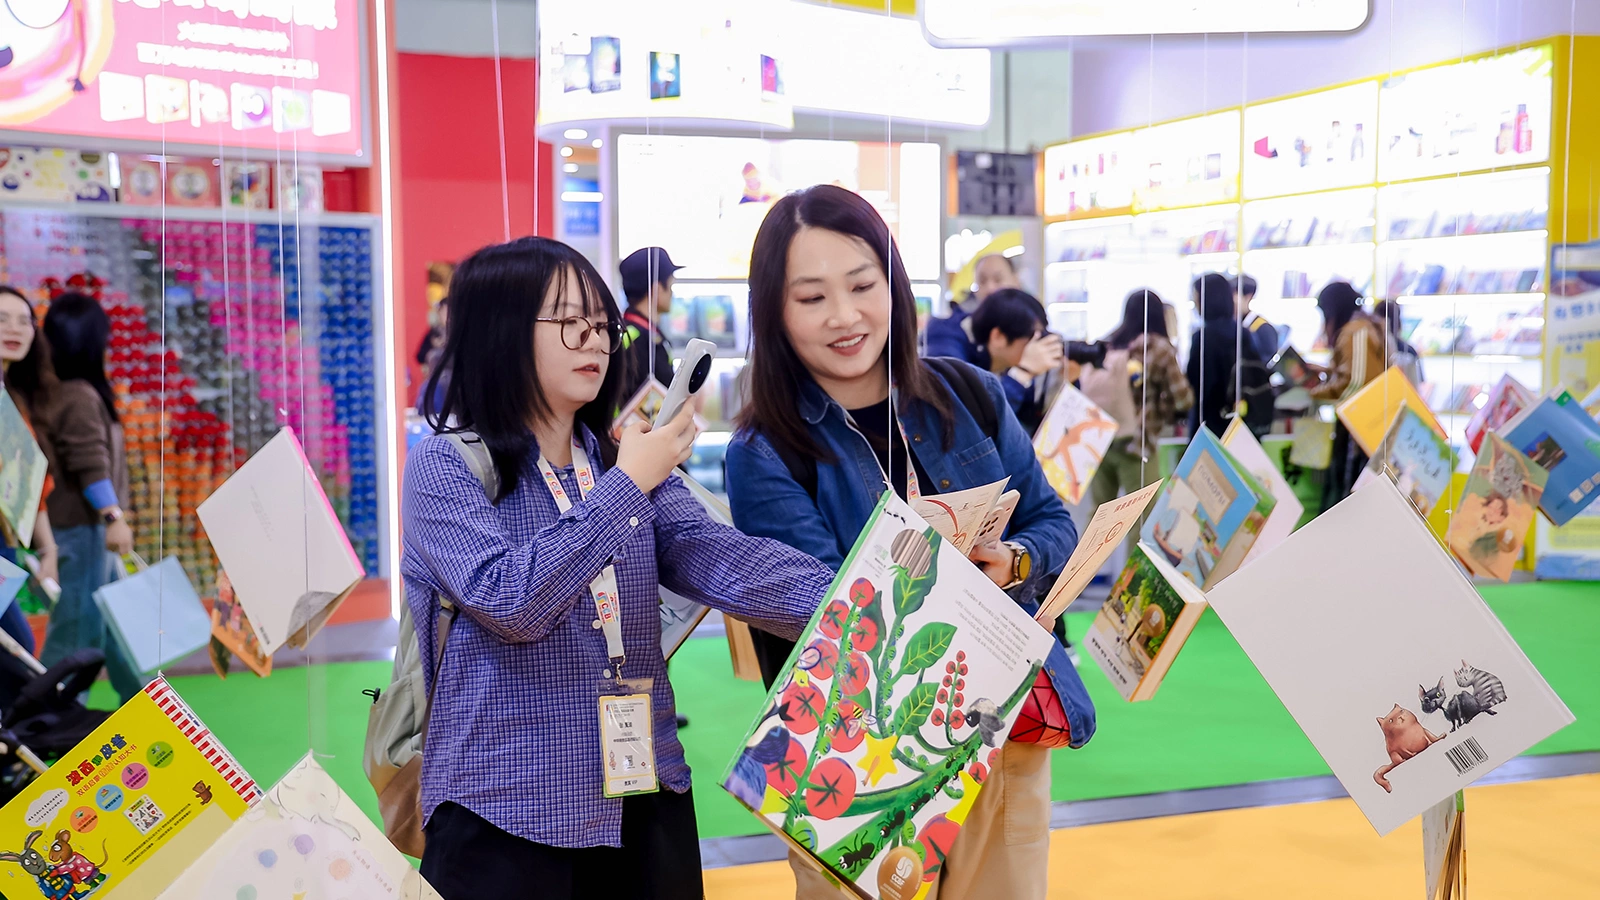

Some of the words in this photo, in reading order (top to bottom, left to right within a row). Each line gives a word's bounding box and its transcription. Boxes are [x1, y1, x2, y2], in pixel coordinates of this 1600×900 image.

[66, 733, 128, 787] 波西和皮普
